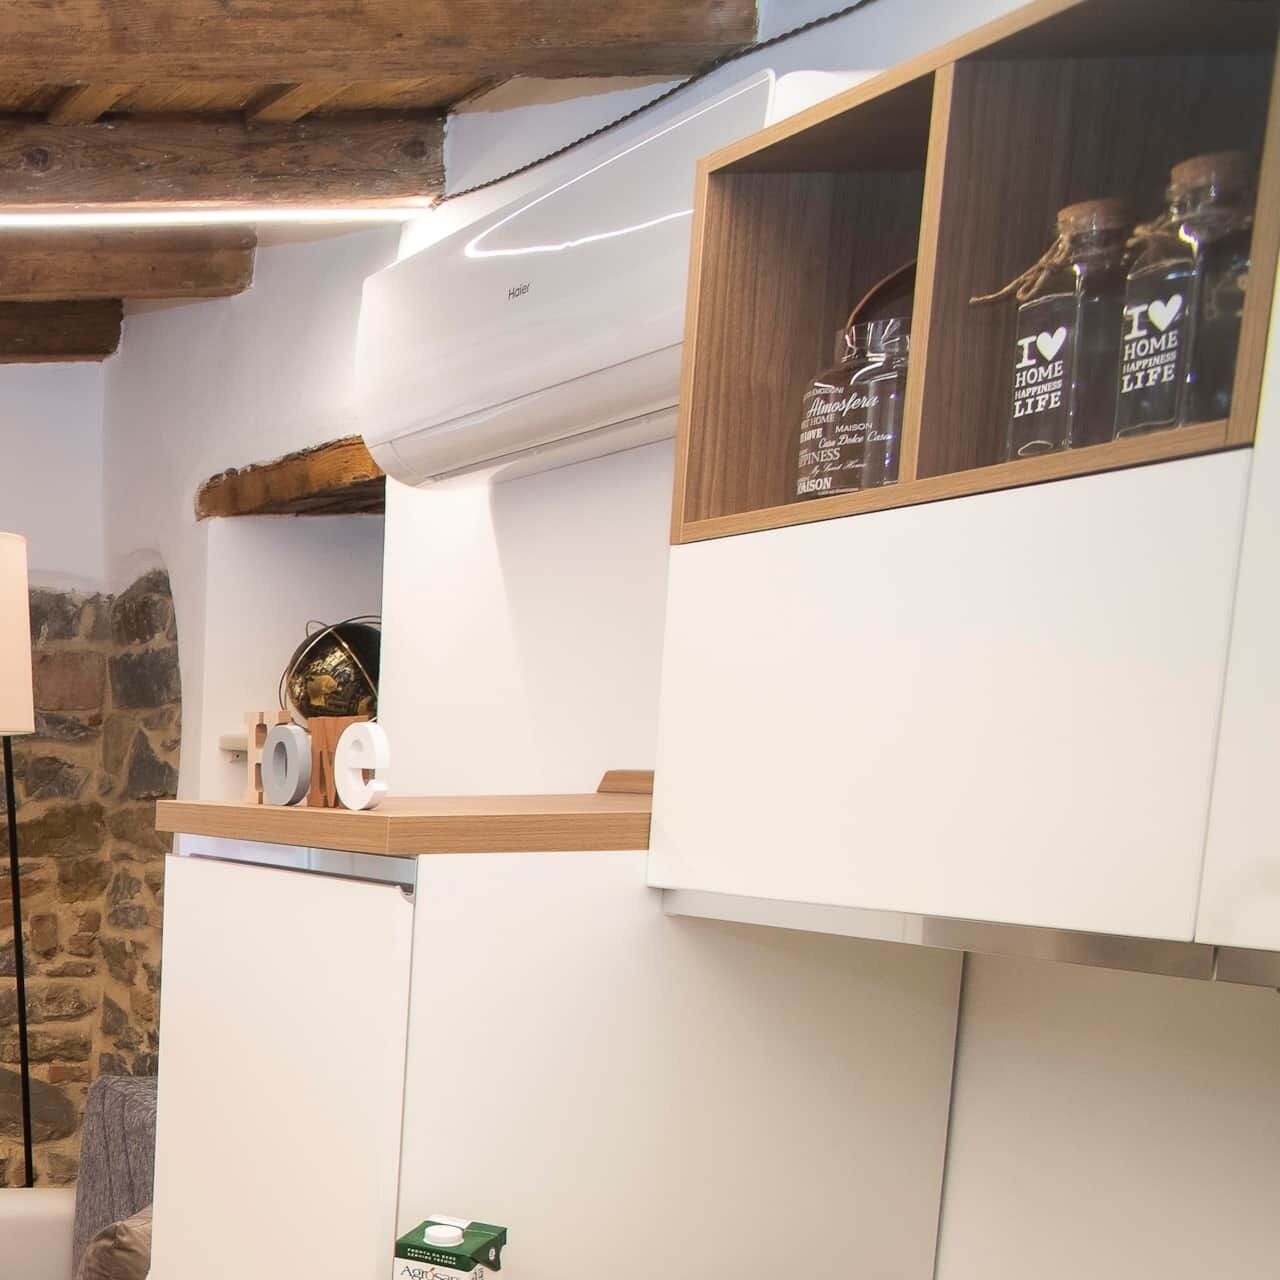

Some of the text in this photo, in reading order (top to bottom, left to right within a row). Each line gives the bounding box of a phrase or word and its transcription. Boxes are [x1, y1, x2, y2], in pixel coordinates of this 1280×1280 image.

[508, 283, 530, 300] Haier
[1124, 303, 1149, 341] I
[1015, 335, 1038, 369] I
[1123, 330, 1178, 361] HOME
[1014, 360, 1064, 388] HOME
[1122, 351, 1177, 375] HAPPINESS
[1014, 379, 1063, 400] HAPPINESS
[1121, 363, 1176, 393] LIFE
[808, 392, 880, 417] Atmosfera
[1013, 391, 1062, 418] LIFE
[835, 422, 873, 433] MAISON
